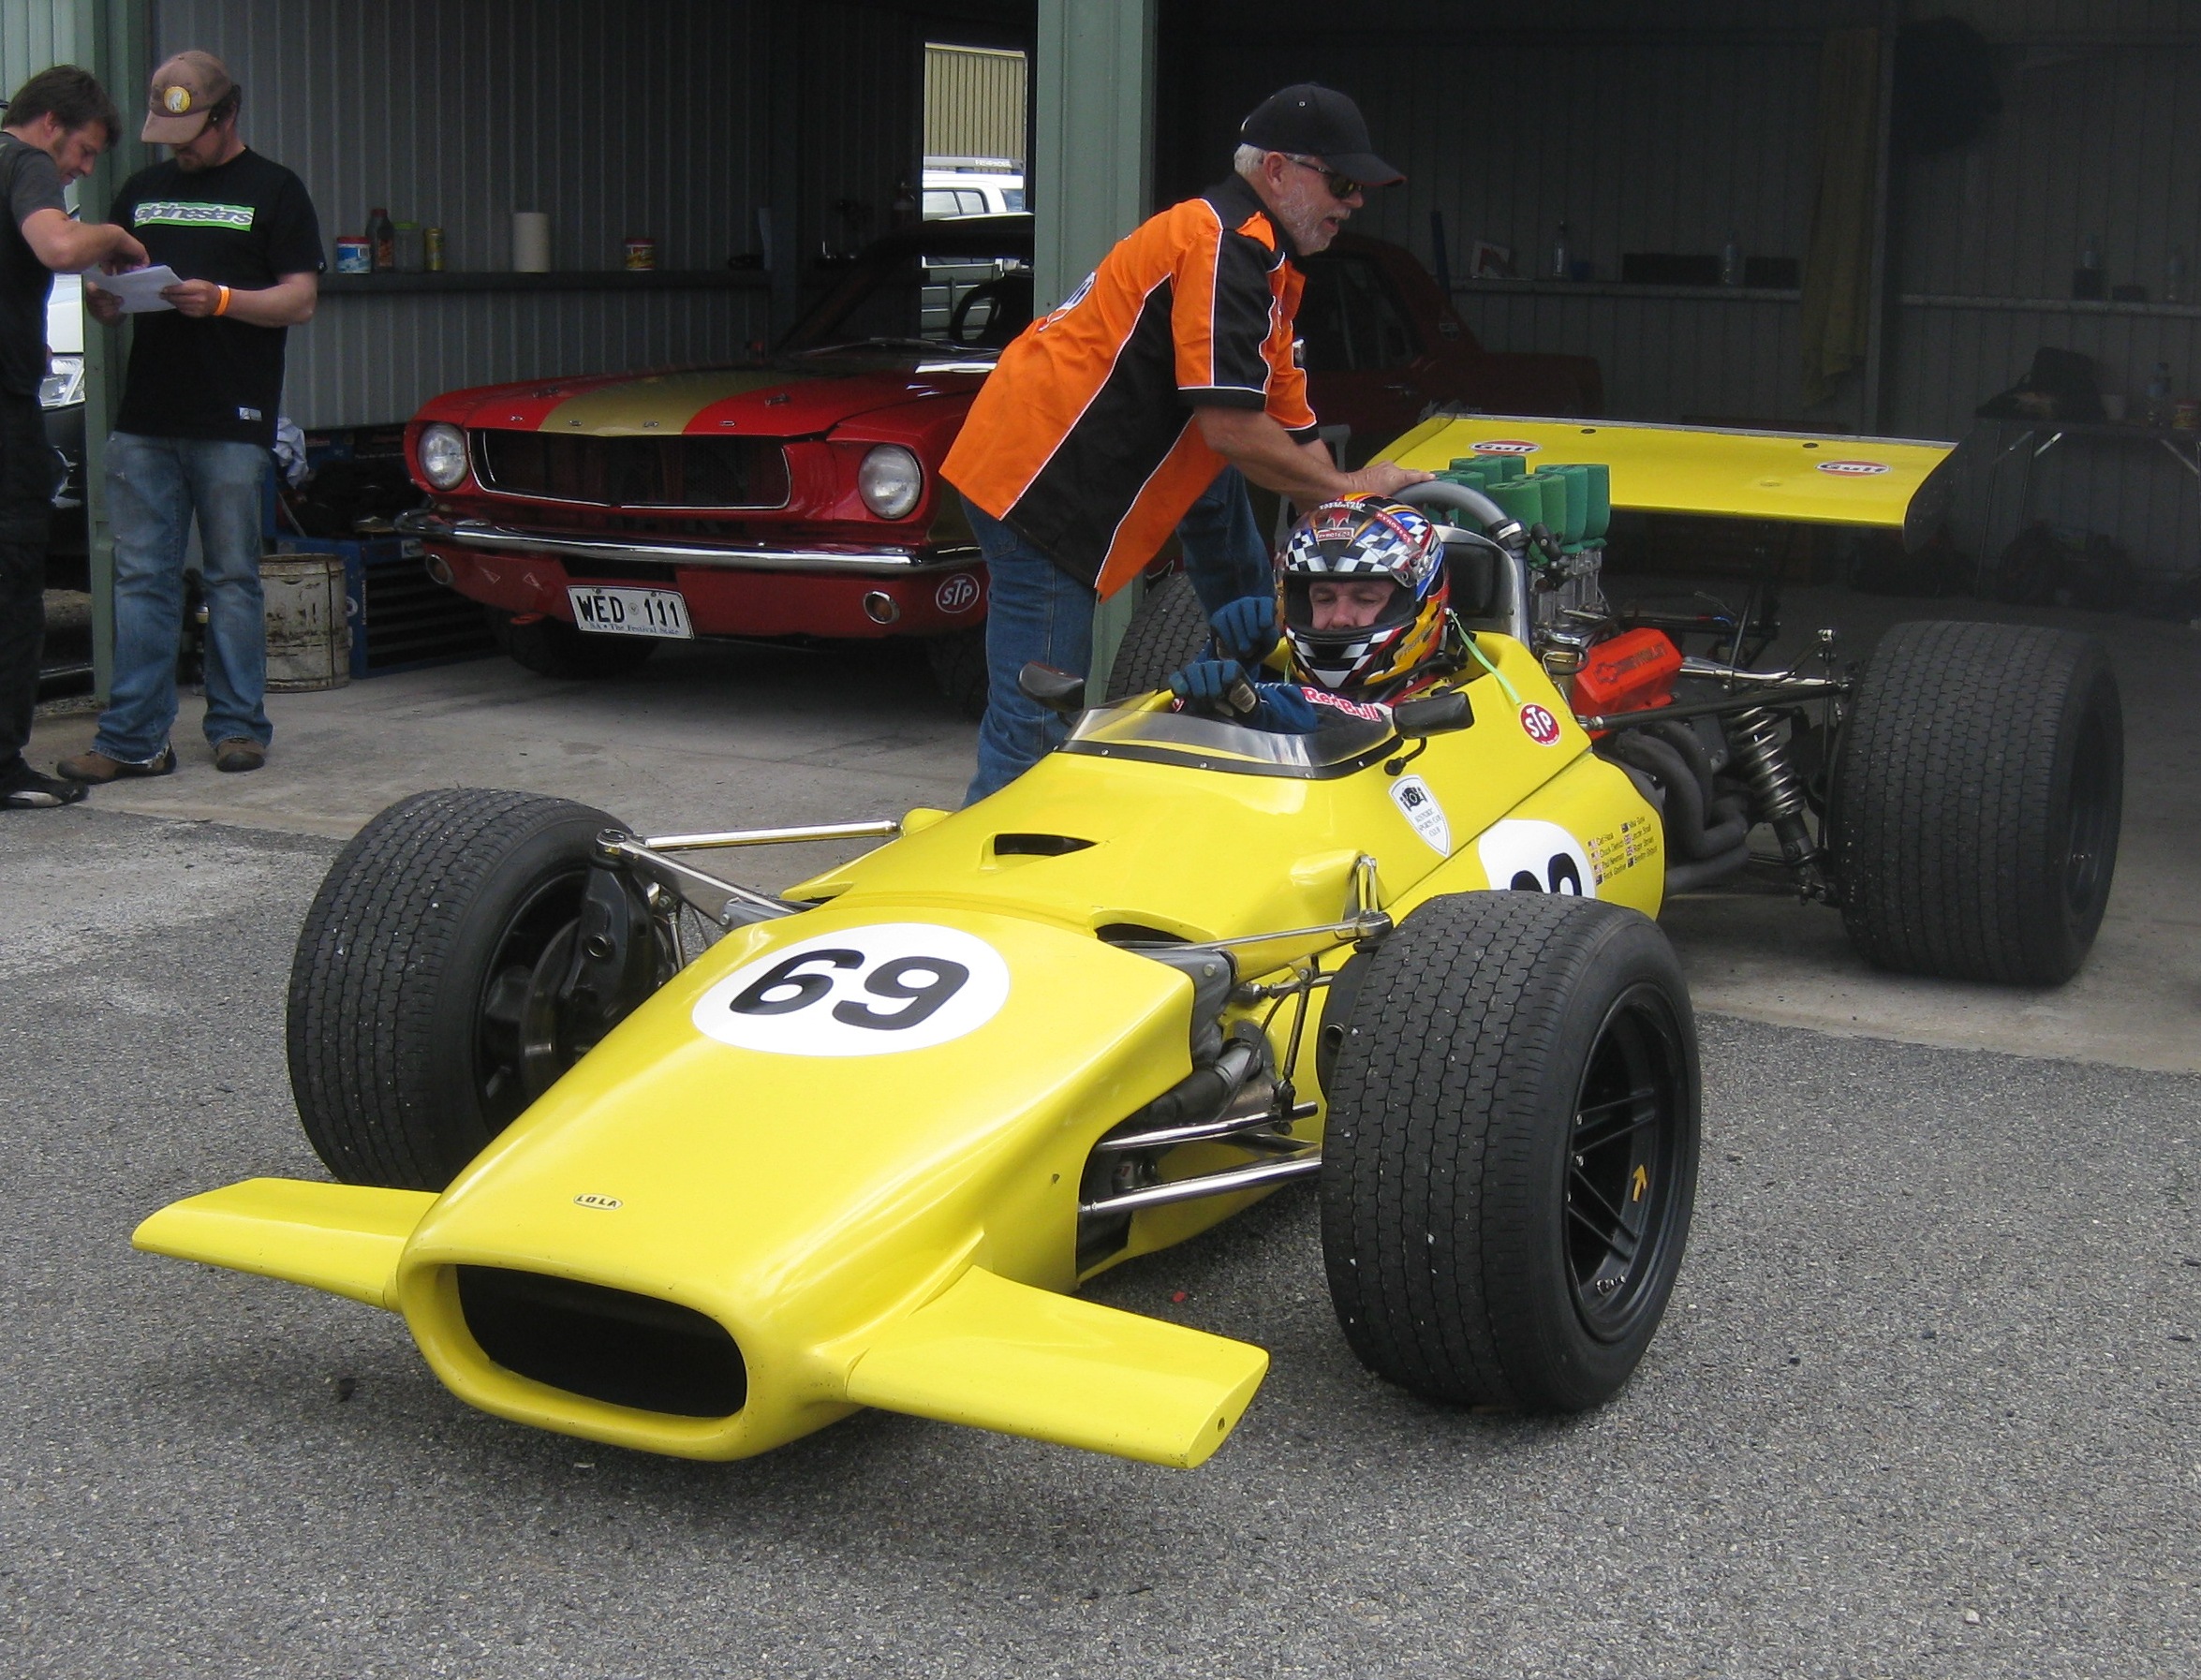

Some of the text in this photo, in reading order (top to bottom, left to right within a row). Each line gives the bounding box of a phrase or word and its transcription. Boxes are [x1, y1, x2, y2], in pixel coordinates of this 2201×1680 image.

[1473, 444, 1536, 452] Gulf
[1819, 464, 1886, 473] Gulf
[941, 579, 973, 606] STP
[576, 595, 681, 628] WED 111
[1525, 706, 1552, 738] STP
[729, 949, 970, 1031] 69
[576, 1195, 617, 1208] LOLA
